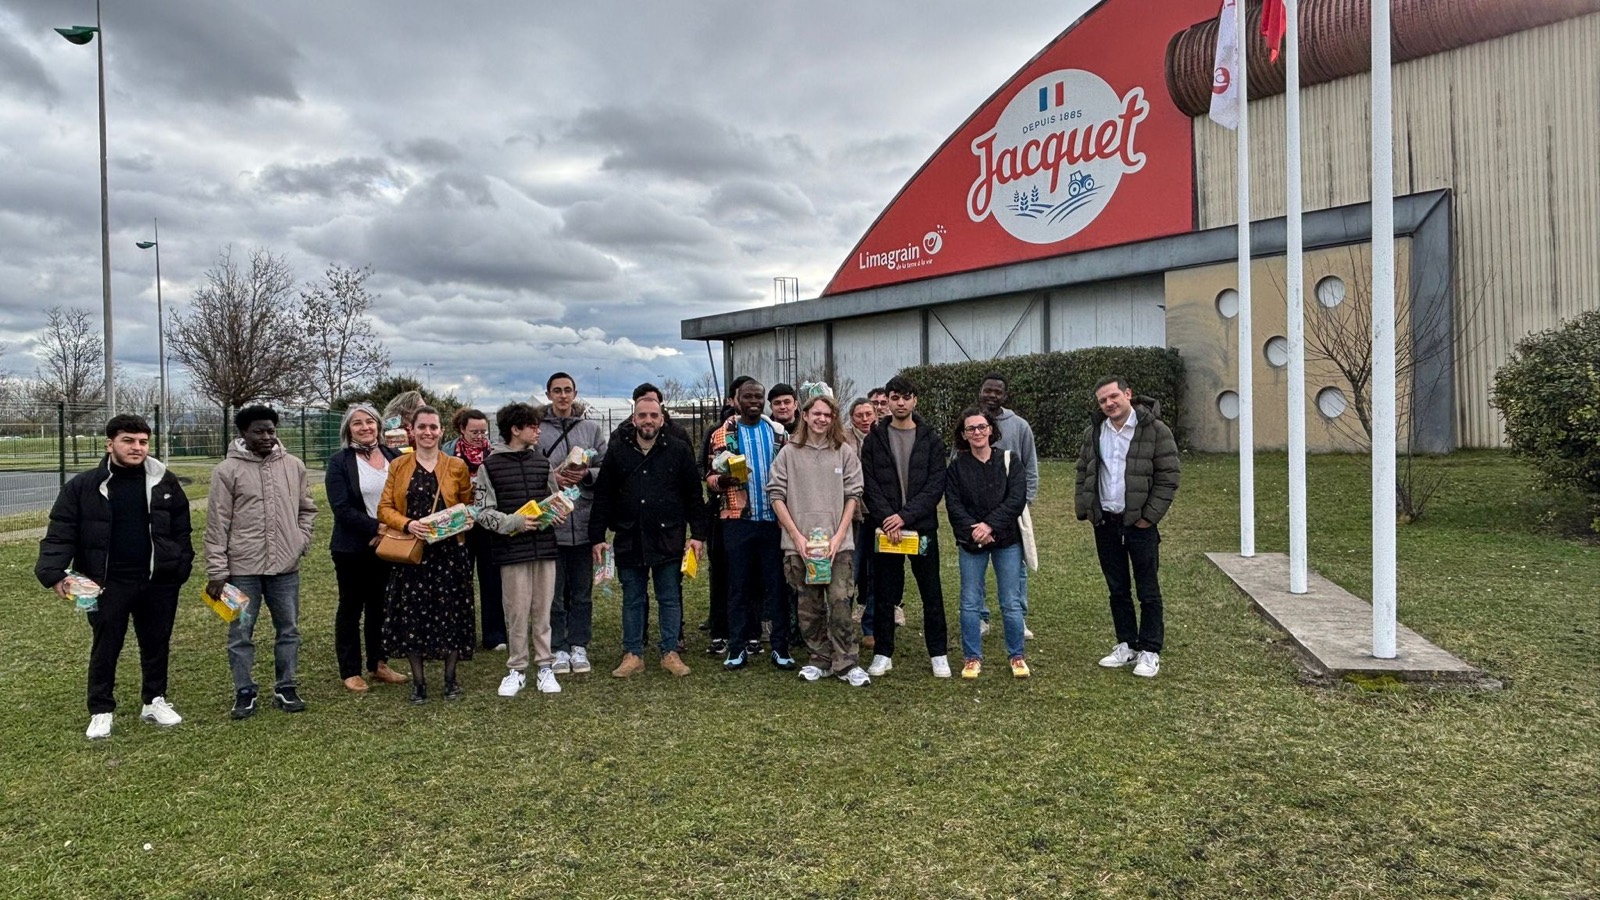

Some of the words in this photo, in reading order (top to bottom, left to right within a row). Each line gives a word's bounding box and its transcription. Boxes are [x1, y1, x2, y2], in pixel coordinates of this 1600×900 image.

[1022, 115, 1056, 134] DEPUIS
[1060, 109, 1082, 121] 1885
[971, 94, 1144, 217] Jacquet
[859, 242, 920, 270] Limagrain
